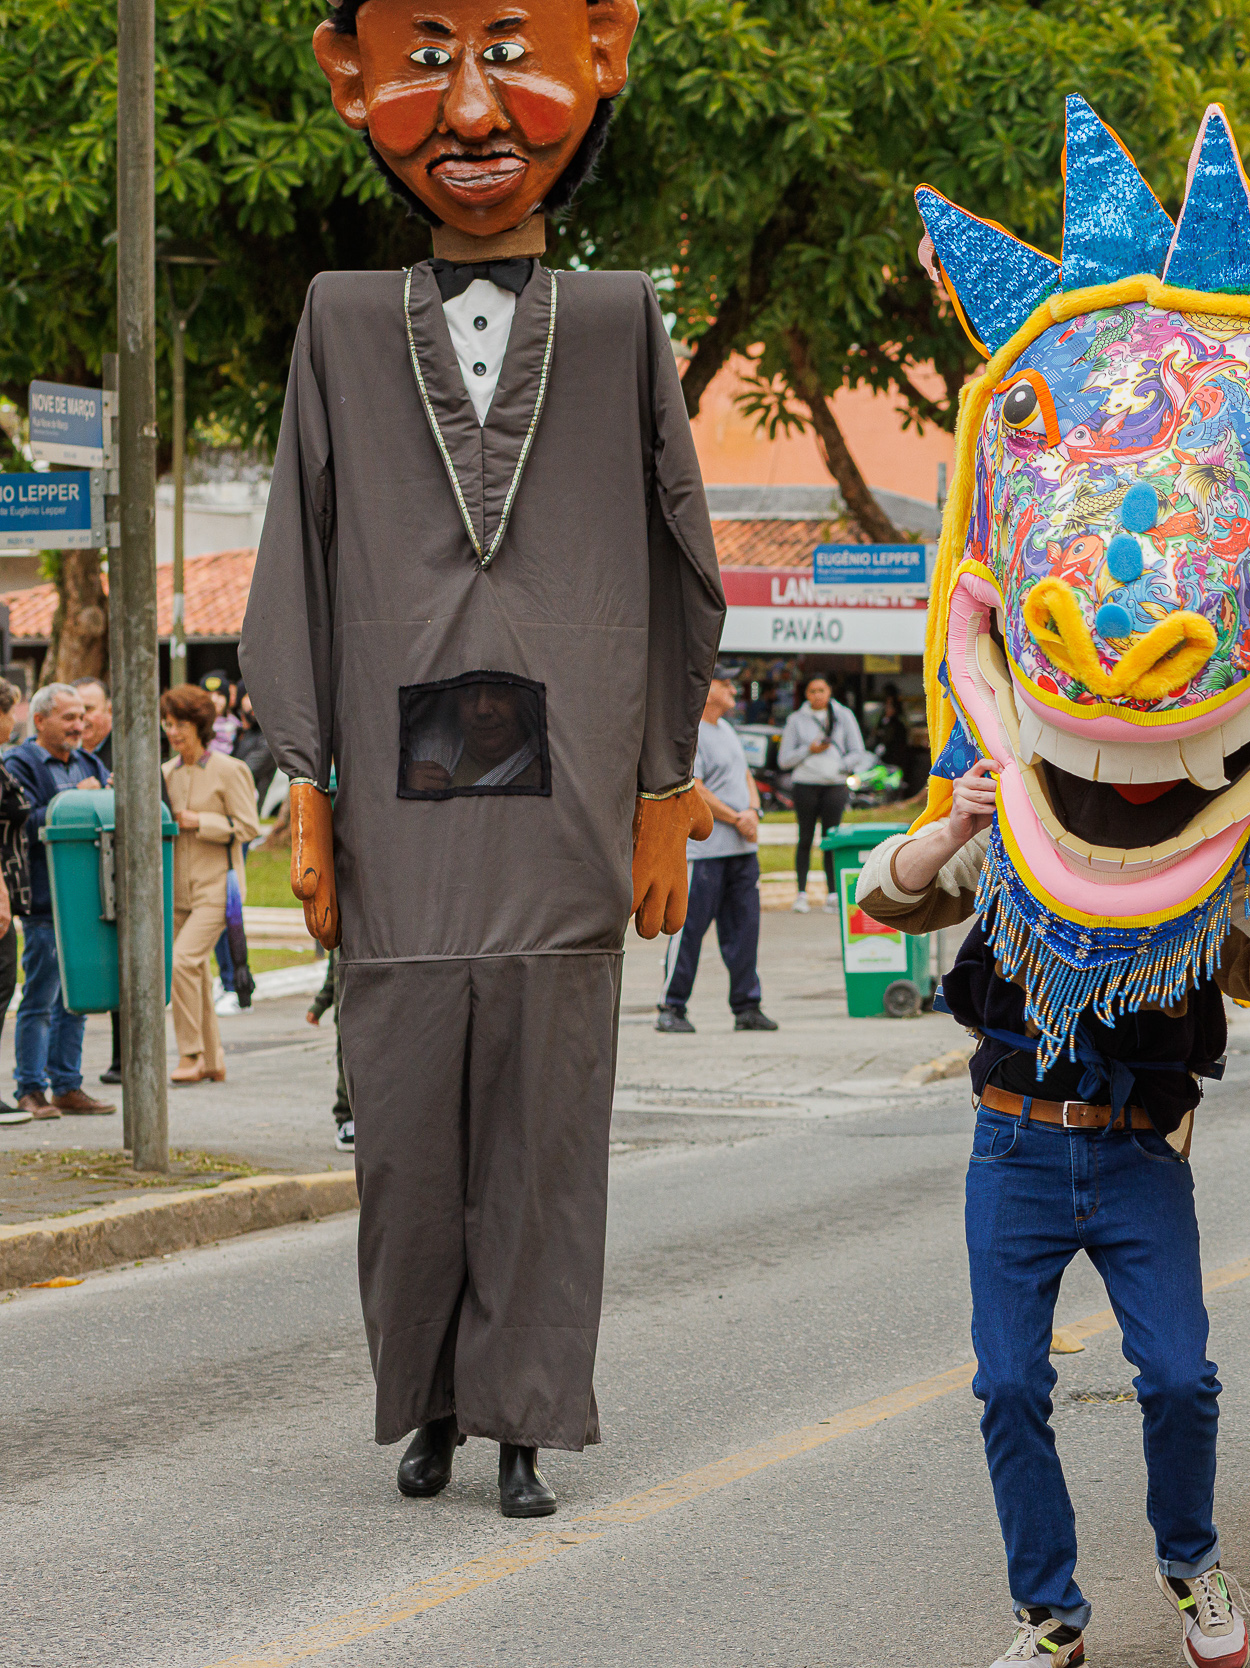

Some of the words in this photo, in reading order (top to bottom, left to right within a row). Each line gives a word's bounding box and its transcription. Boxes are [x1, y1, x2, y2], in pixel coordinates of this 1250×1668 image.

[31, 393, 54, 413] NOVE
[55, 396, 66, 414] DE
[67, 397, 96, 421] MARÇO
[19, 483, 80, 502] LEPPER
[41, 505, 67, 517] Lepper
[816, 550, 871, 566] EUGÊNIO
[872, 551, 920, 566] LEPPER
[771, 612, 843, 642] PAVÃO
